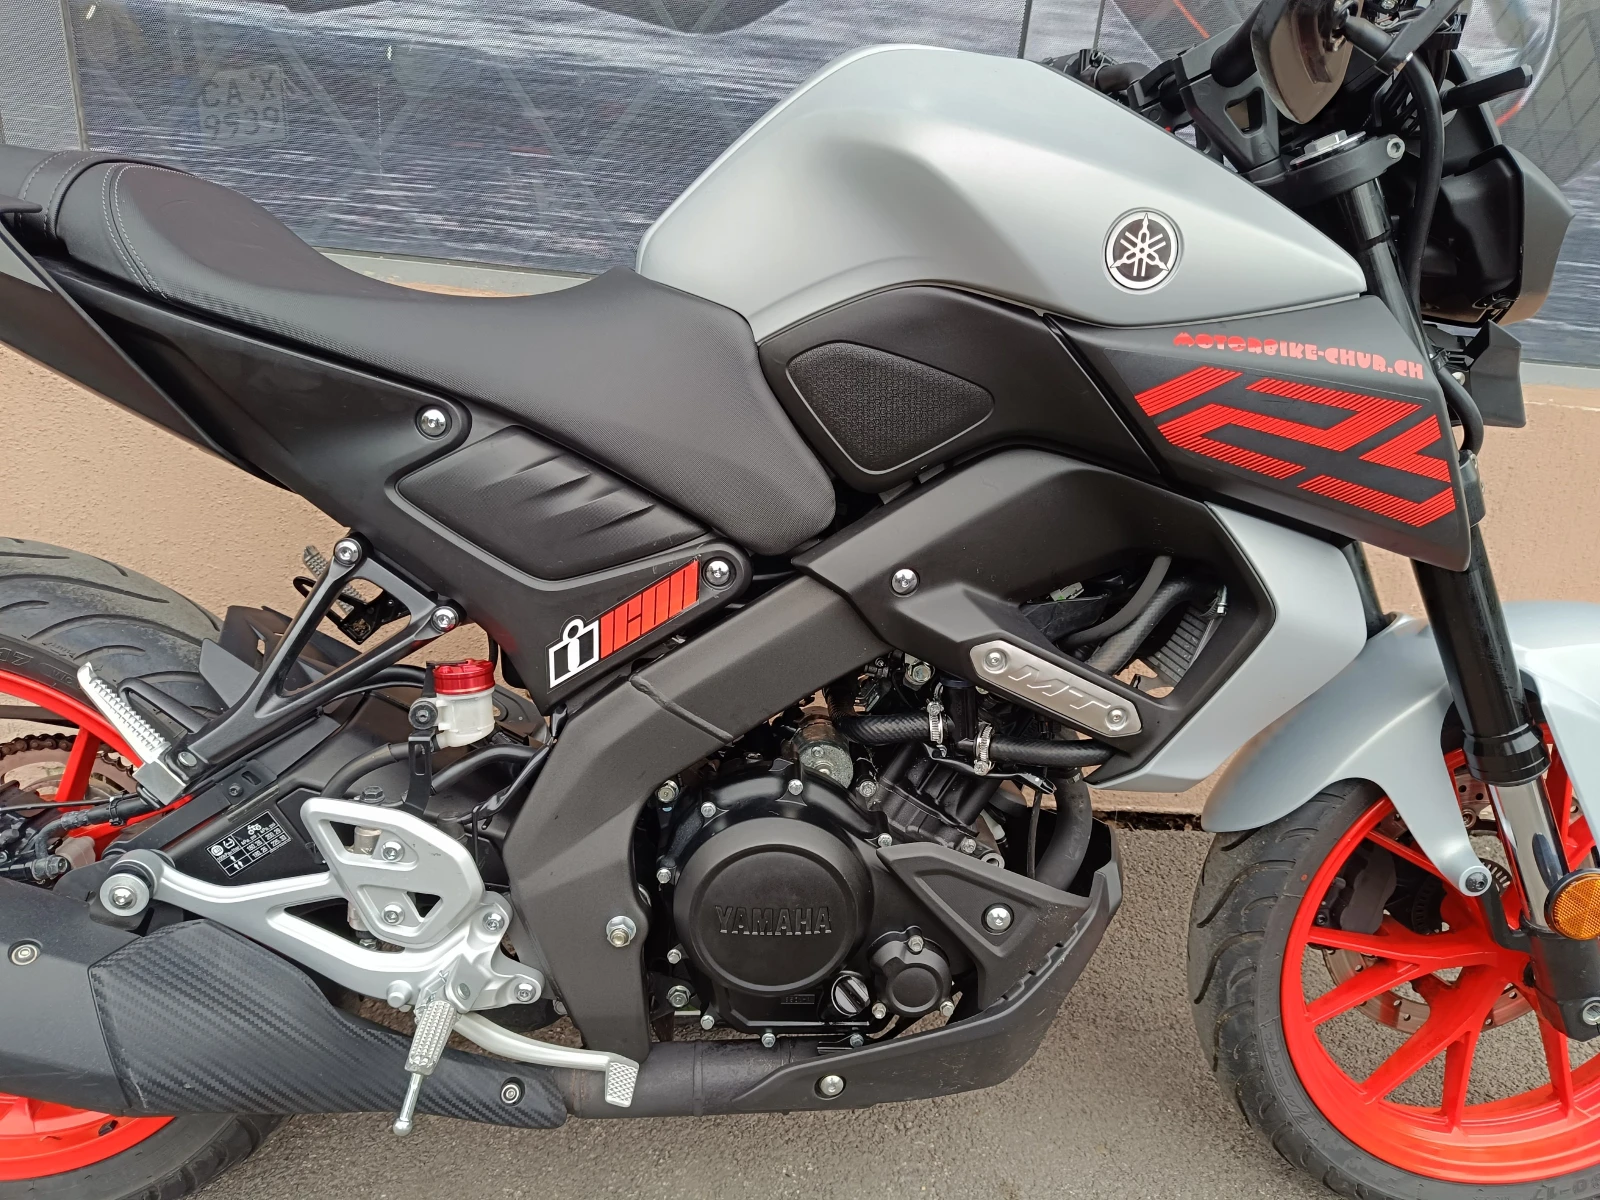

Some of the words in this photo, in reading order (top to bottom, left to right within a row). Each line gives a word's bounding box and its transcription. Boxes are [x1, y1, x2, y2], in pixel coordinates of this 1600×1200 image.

[1173, 332, 1424, 380] MOTORBIKE-CHUR.CH
[1008, 664, 1112, 710] MT
[715, 904, 832, 936] YAMAHA
